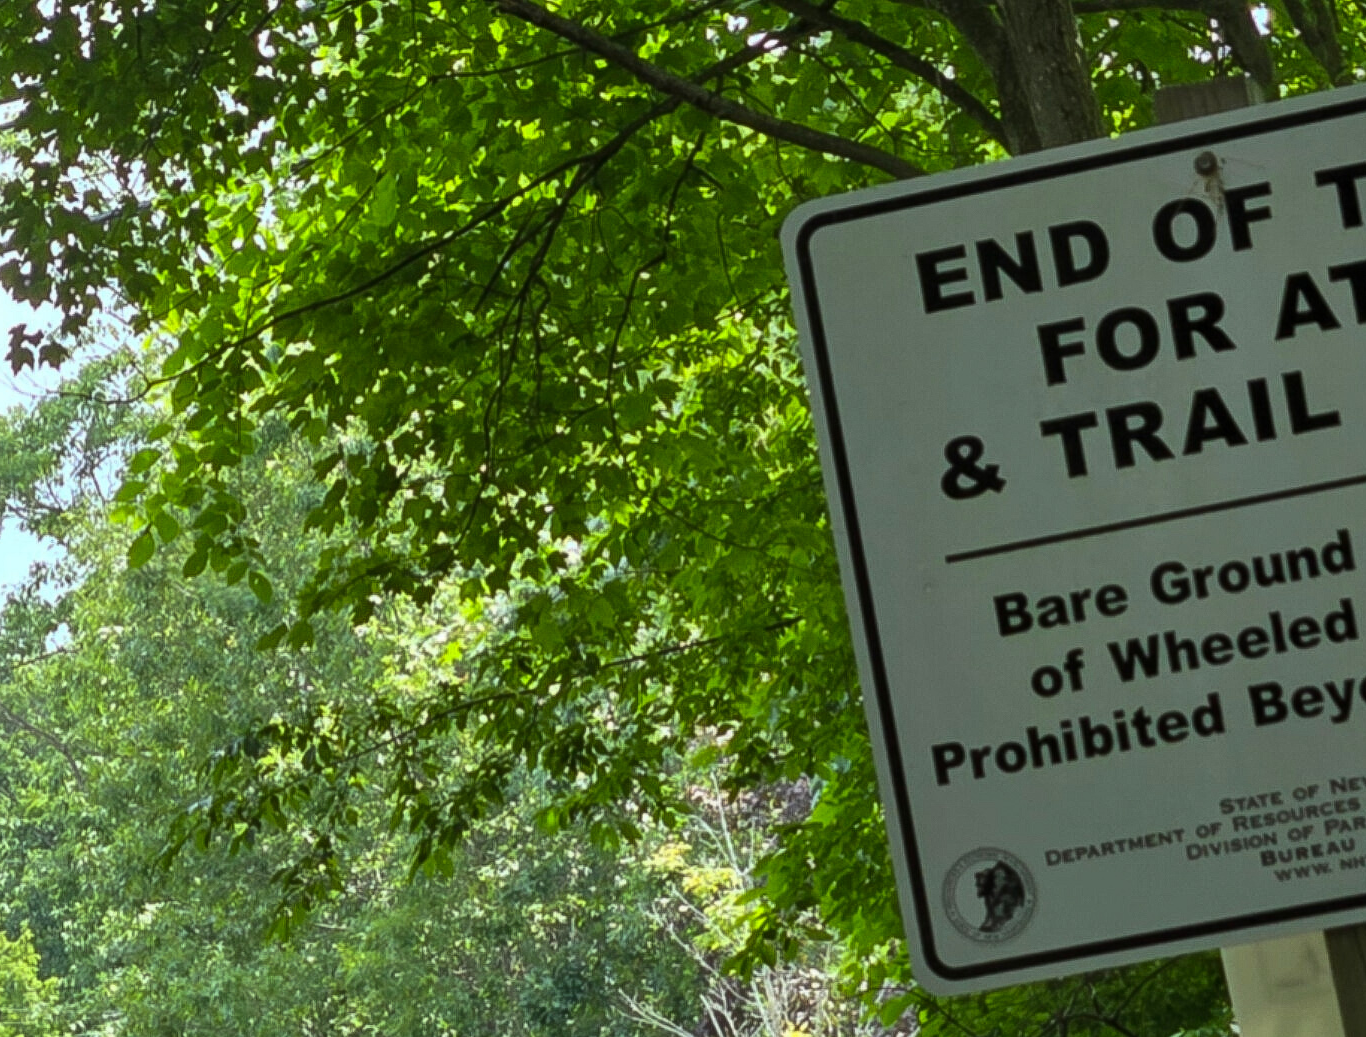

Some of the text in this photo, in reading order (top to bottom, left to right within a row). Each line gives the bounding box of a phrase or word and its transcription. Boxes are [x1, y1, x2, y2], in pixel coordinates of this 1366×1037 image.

[915, 219, 1110, 314] END
[1152, 182, 1273, 262] OF
[1037, 291, 1235, 386] FOR
[940, 435, 1006, 501] &
[1041, 371, 1341, 479] TRAIL
[993, 579, 1128, 637] Bare
[1150, 529, 1356, 606] Ground
[1030, 648, 1087, 699] of
[1109, 599, 1359, 687] Wheeled
[931, 693, 1226, 787] Prohibited
[1260, 838, 1356, 867] BUREAU
